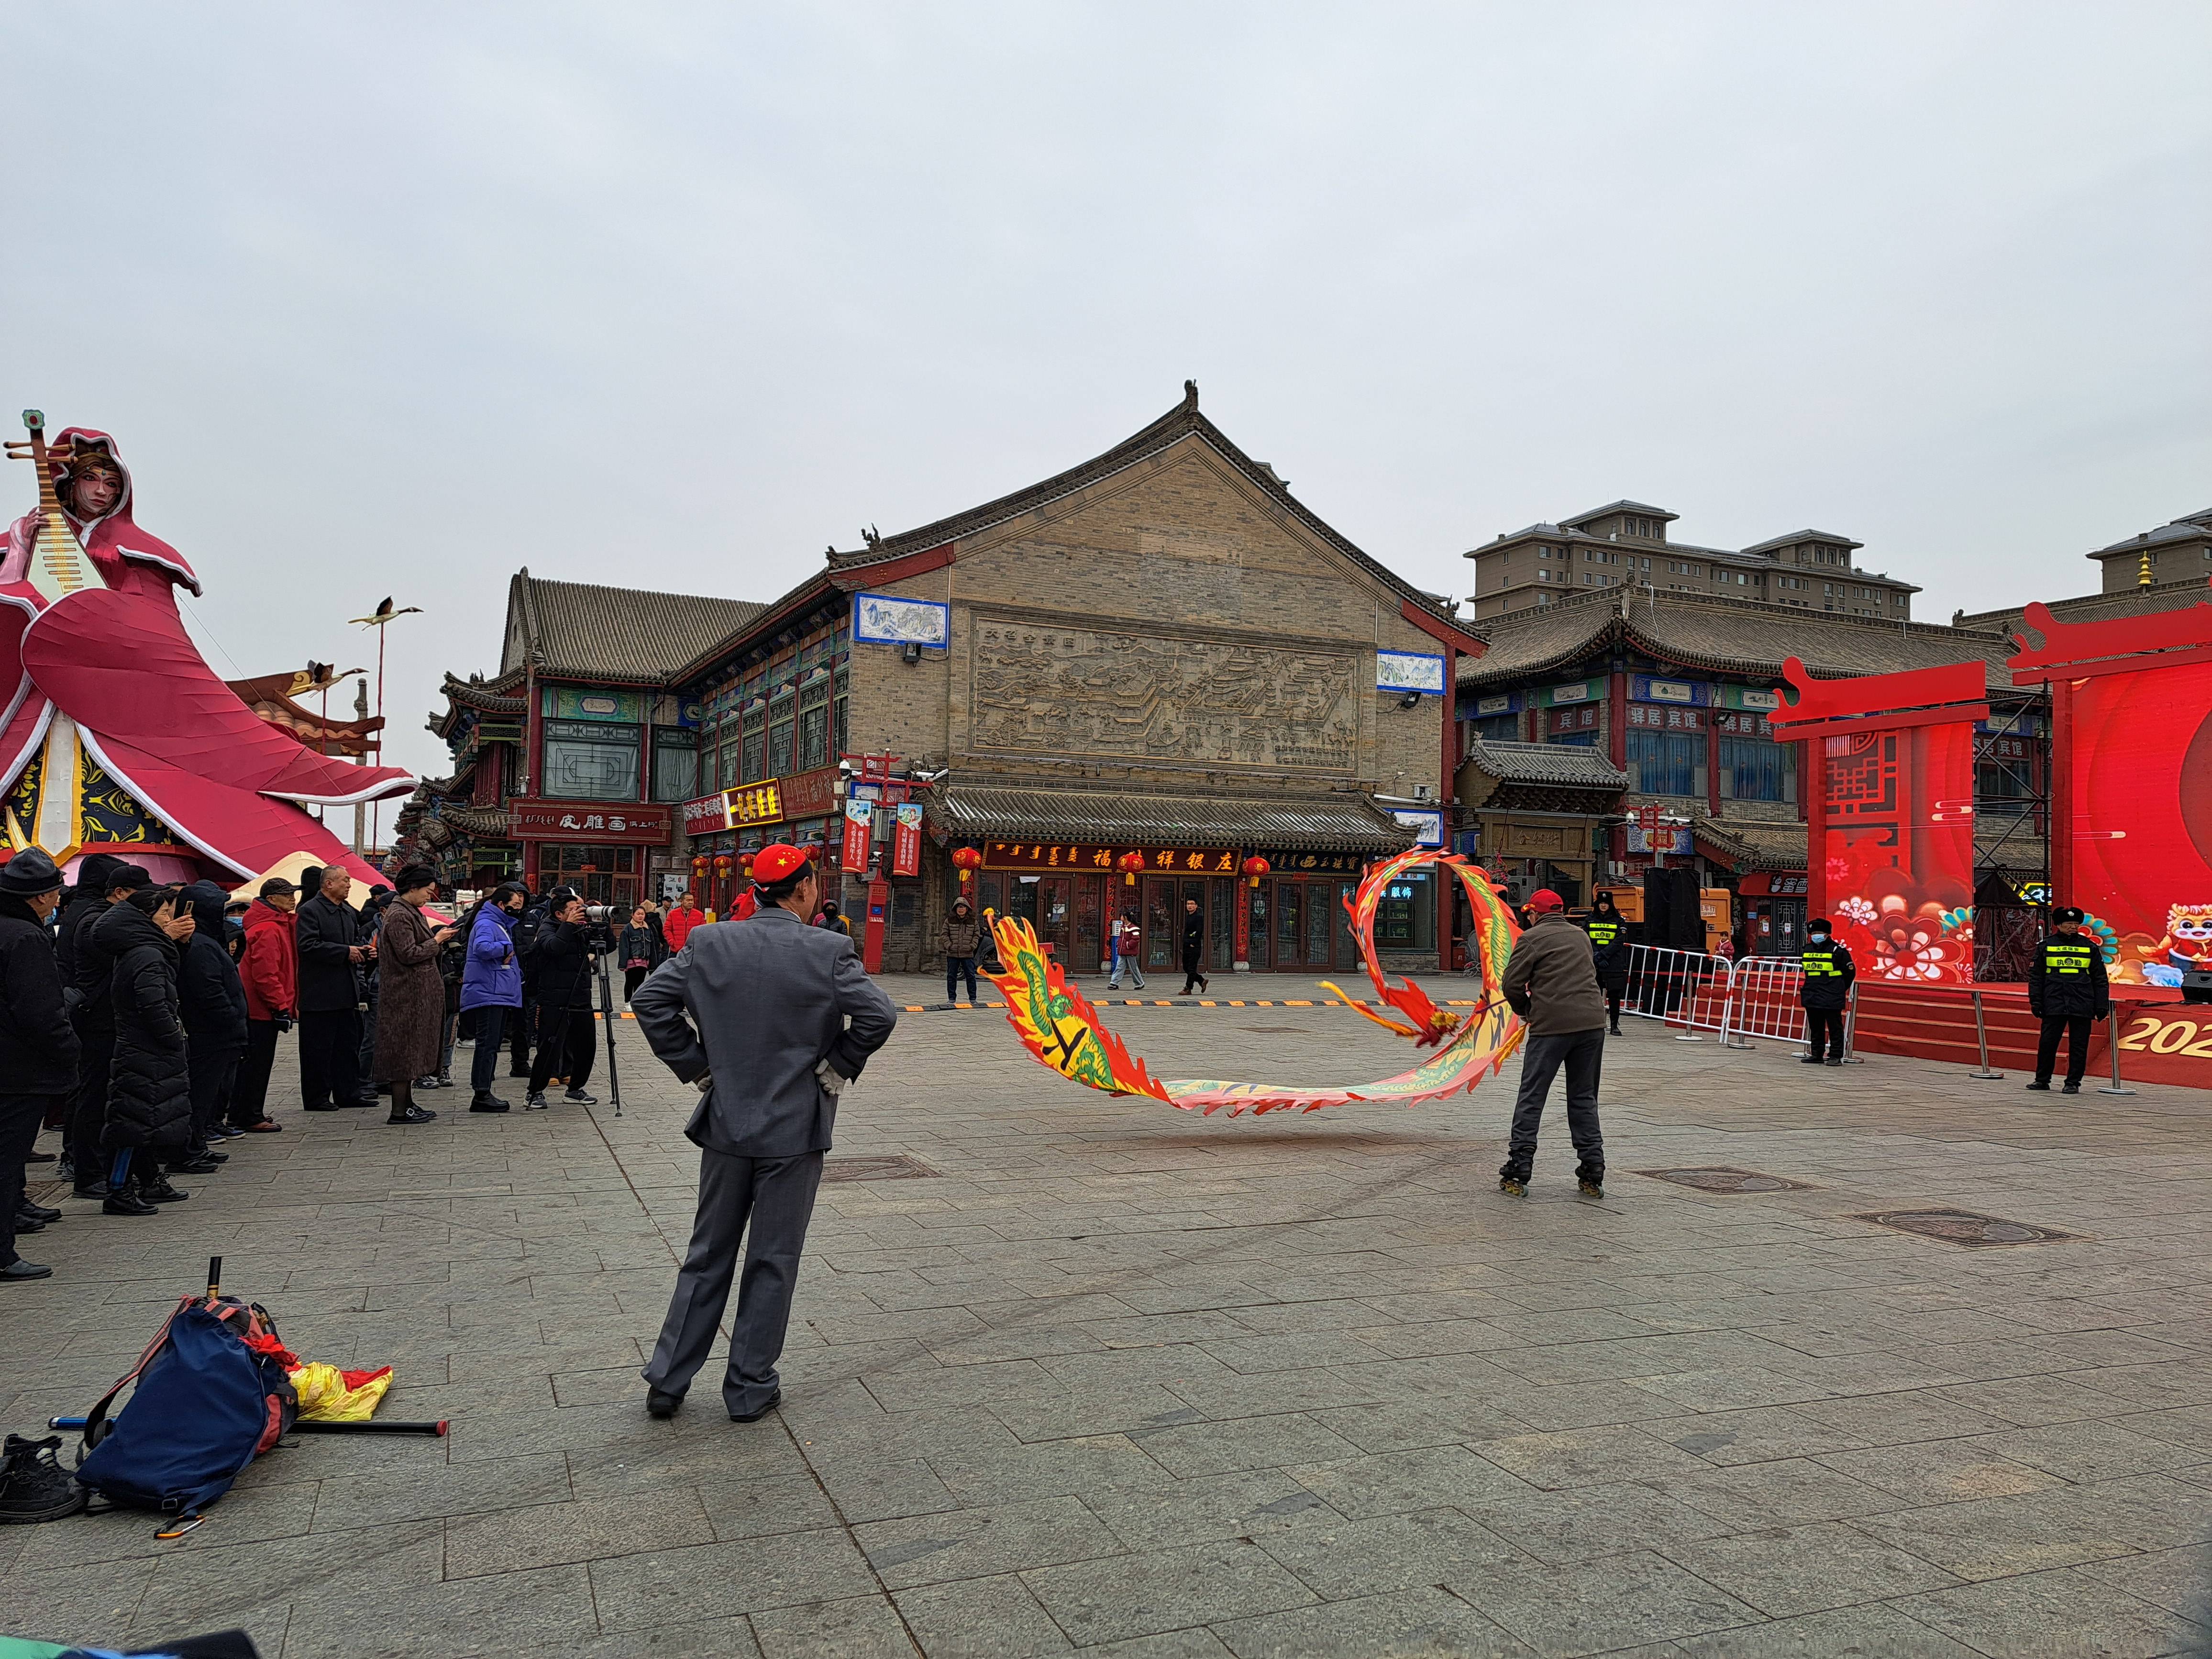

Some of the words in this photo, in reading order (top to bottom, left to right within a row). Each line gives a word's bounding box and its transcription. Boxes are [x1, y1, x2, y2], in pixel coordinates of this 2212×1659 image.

[1559, 708, 1593, 729] 宾馆
[1630, 707, 1697, 729] 驿居宾馆
[559, 813, 626, 831] 皮雕画
[1092, 849, 1233, 871] 福祥银庄
[1391, 886, 1412, 899] 服饰
[1781, 877, 1808, 893] 蜜雪
